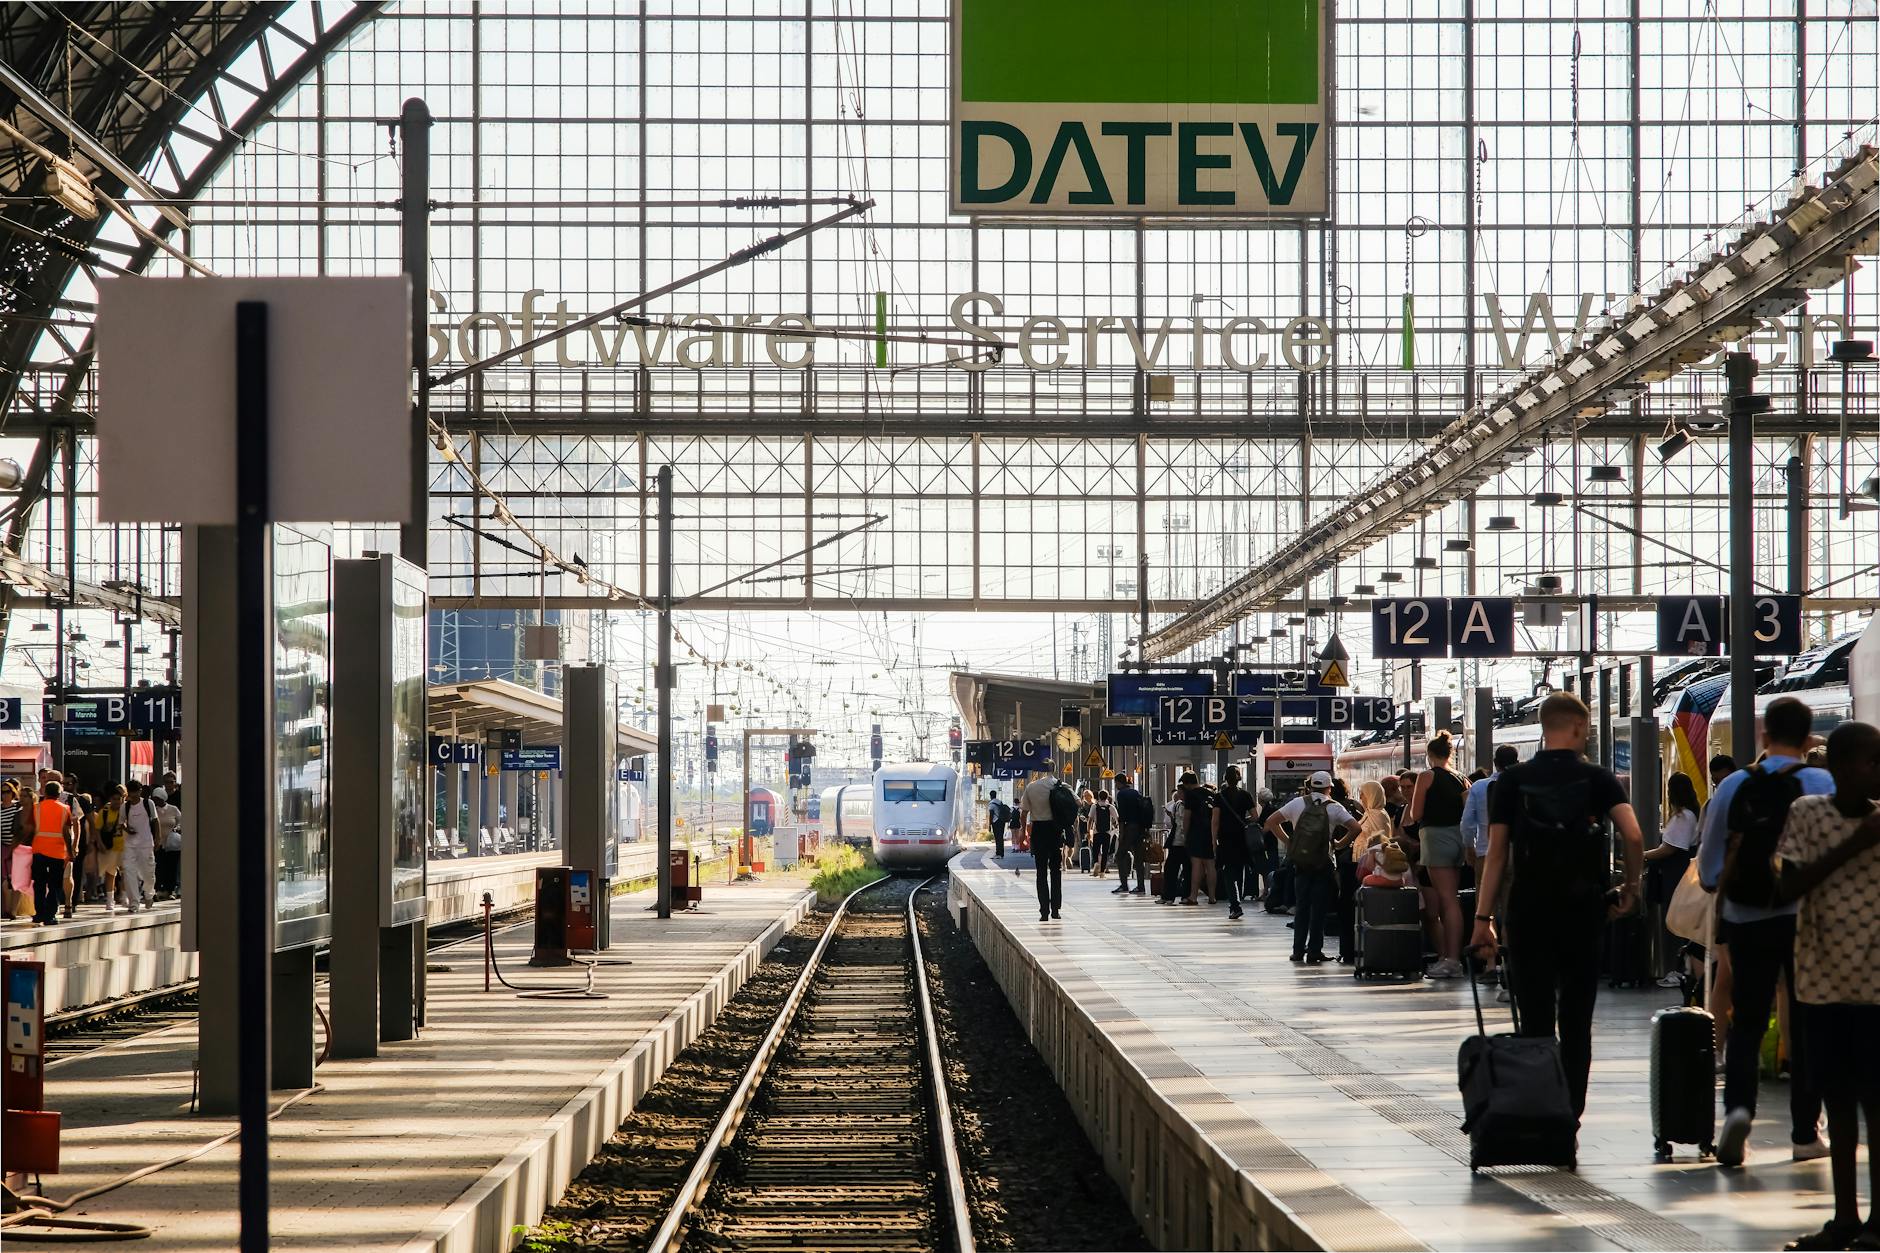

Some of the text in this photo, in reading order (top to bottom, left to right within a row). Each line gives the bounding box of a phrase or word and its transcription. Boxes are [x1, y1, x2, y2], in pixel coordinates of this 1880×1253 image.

[960, 120, 1320, 206] DATEV
[946, 291, 1333, 372] Service
[1379, 600, 1496, 645] 12 A
[1676, 598, 1711, 642] A
[107, 697, 166, 722] B 11
[1164, 698, 1227, 723] 12 B
[1330, 698, 1392, 723] B 13
[995, 740, 1035, 757] 12 C
[1166, 731, 1186, 741] 1-11
[438, 743, 476, 760] C 11
[621, 770, 628, 779] E
